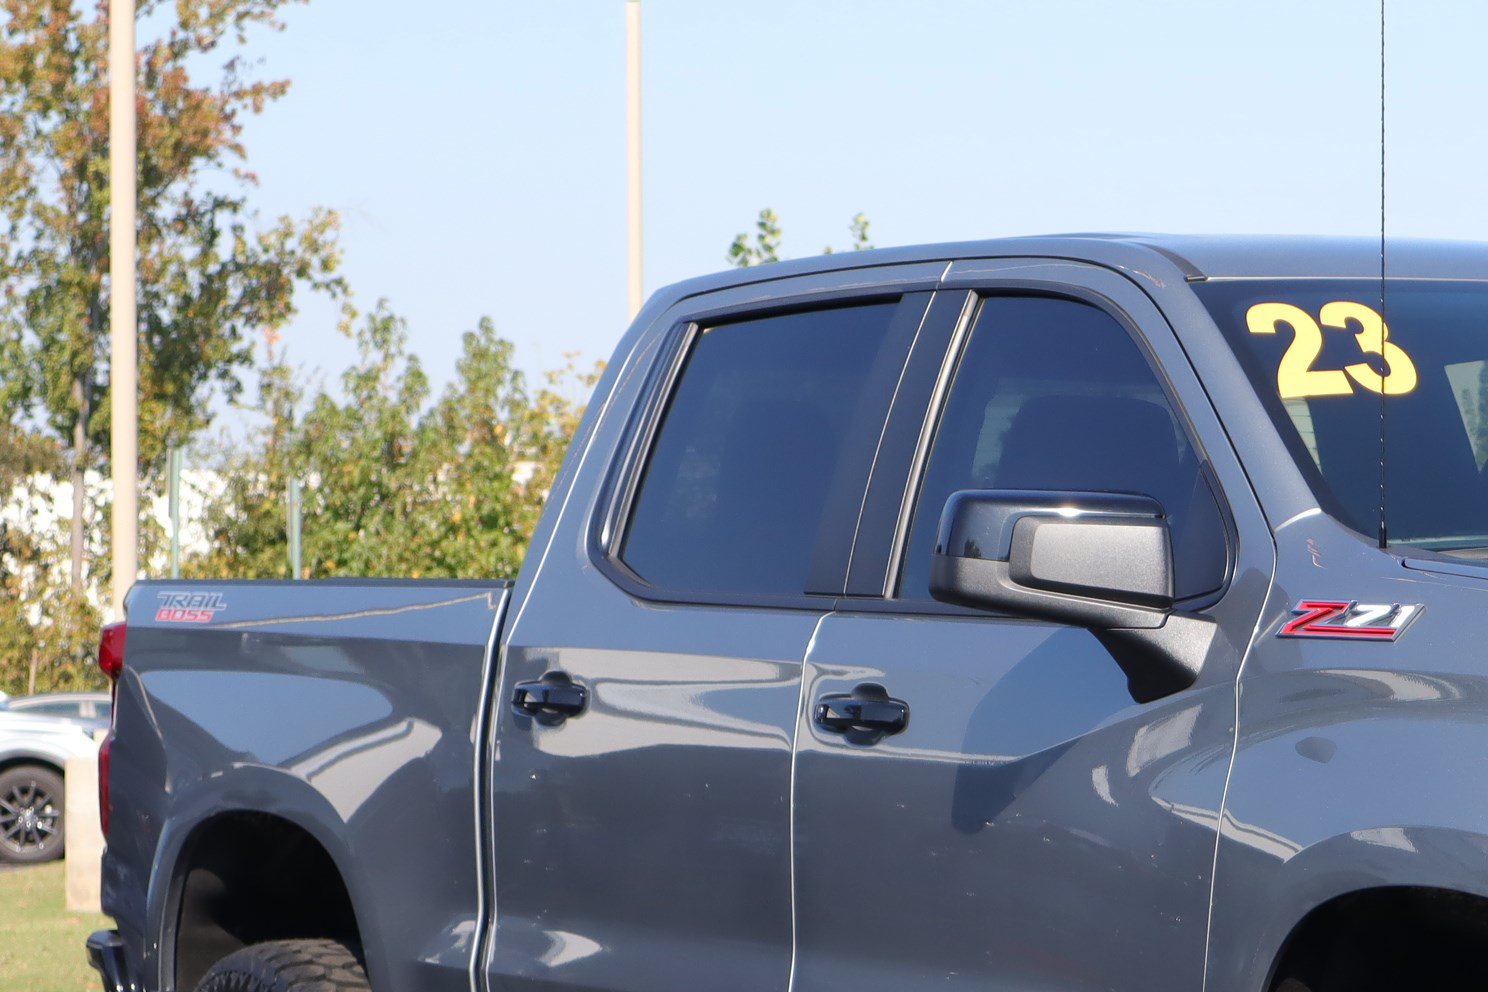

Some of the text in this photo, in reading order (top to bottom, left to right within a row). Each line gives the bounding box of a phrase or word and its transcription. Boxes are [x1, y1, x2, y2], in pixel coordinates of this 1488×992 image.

[1245, 301, 1419, 398] 23
[155, 609, 215, 623] BOSS
[157, 591, 227, 610] TRAIL
[1275, 599, 1426, 643] Z71
